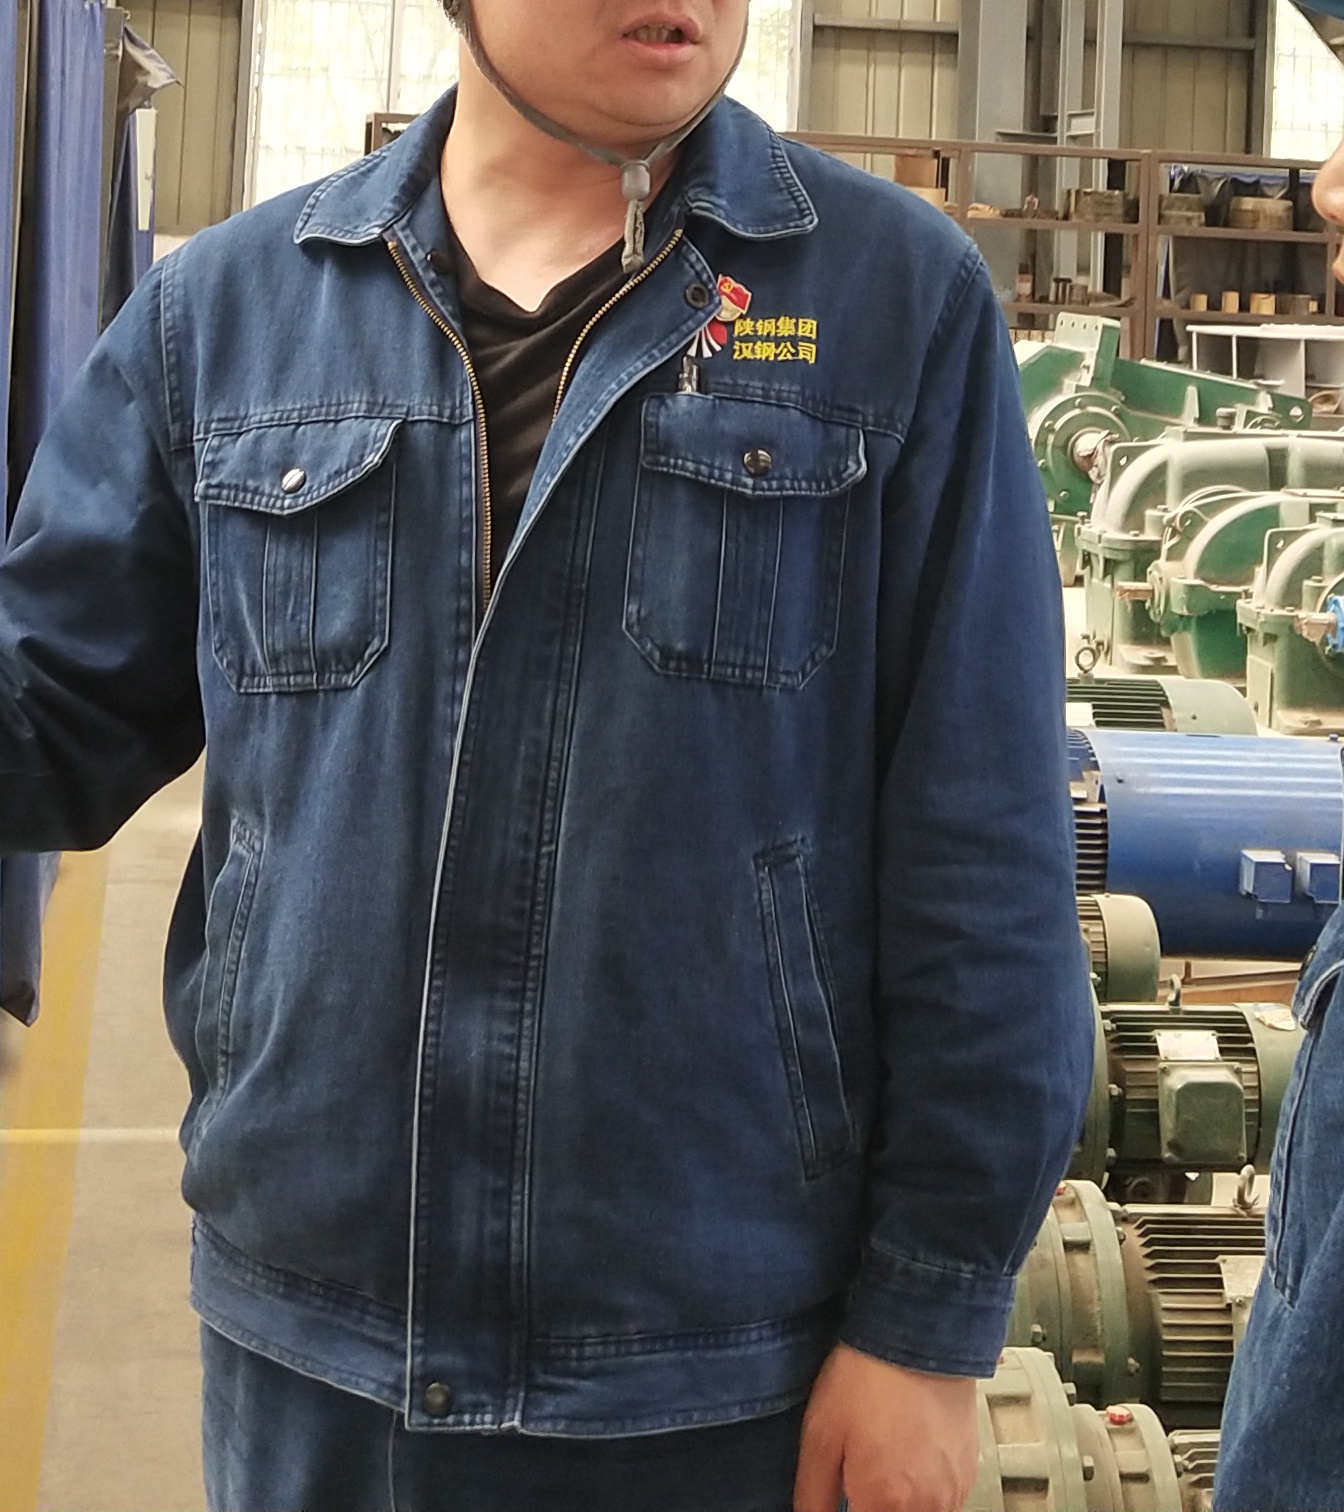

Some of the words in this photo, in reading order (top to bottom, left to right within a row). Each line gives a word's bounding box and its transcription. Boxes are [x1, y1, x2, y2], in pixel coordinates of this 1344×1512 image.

[733, 316, 817, 339] 陕钢集团
[733, 341, 817, 364] 汉钢公司
